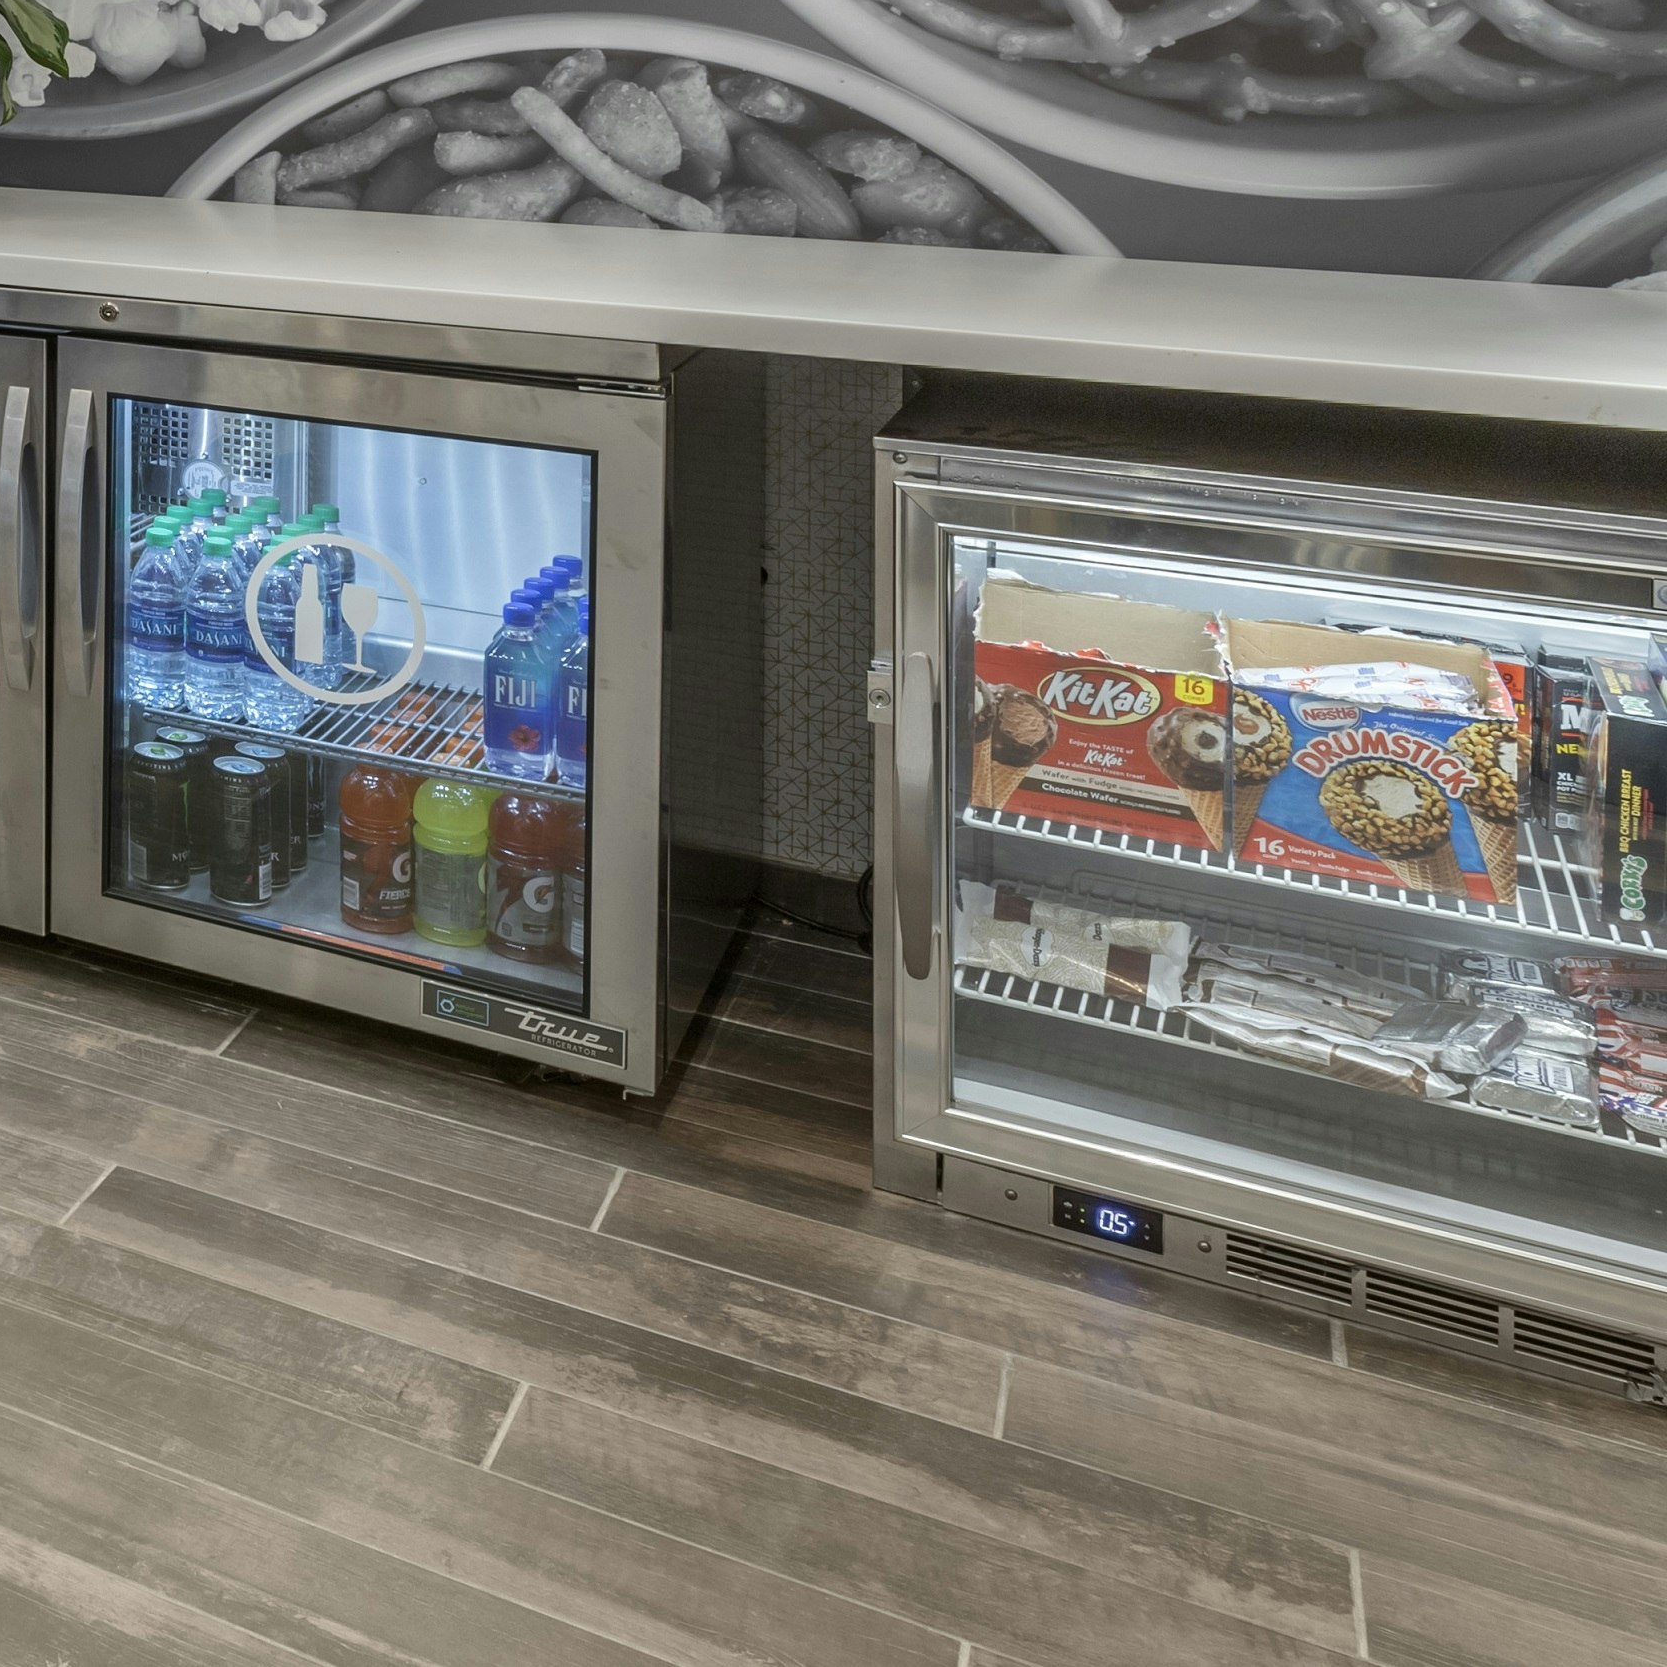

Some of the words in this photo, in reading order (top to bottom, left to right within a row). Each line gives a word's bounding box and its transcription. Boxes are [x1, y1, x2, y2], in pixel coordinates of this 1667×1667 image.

[130, 619, 178, 638] DASANI
[195, 629, 244, 648] DASANI
[494, 674, 538, 708] FIJI
[1043, 671, 1153, 720] KitKat
[1181, 677, 1205, 697] 16
[1068, 738, 1088, 749] Enjoy
[1101, 744, 1125, 754] TASTE
[1083, 749, 1125, 768] KitKat
[1295, 731, 1477, 798] DRUMSTICK
[1041, 768, 1069, 781] Wafer
[1088, 776, 1118, 790] Fudge
[1556, 772, 1574, 782] XL
[1621, 769, 1632, 800] BREAST
[1041, 783, 1089, 799] Chocolate
[1090, 790, 1119, 804] Wafer
[1631, 786, 1642, 818] DINNER
[1620, 800, 1631, 834] CHICKEN
[1253, 837, 1285, 857] 16
[1288, 845, 1317, 858] Variety
[1317, 849, 1336, 860] Pack
[1619, 834, 1632, 853] BBQ
[523, 876, 554, 913] G
[504, 1007, 610, 1052] true
[530, 1033, 598, 1058] REFRIGERATOR
